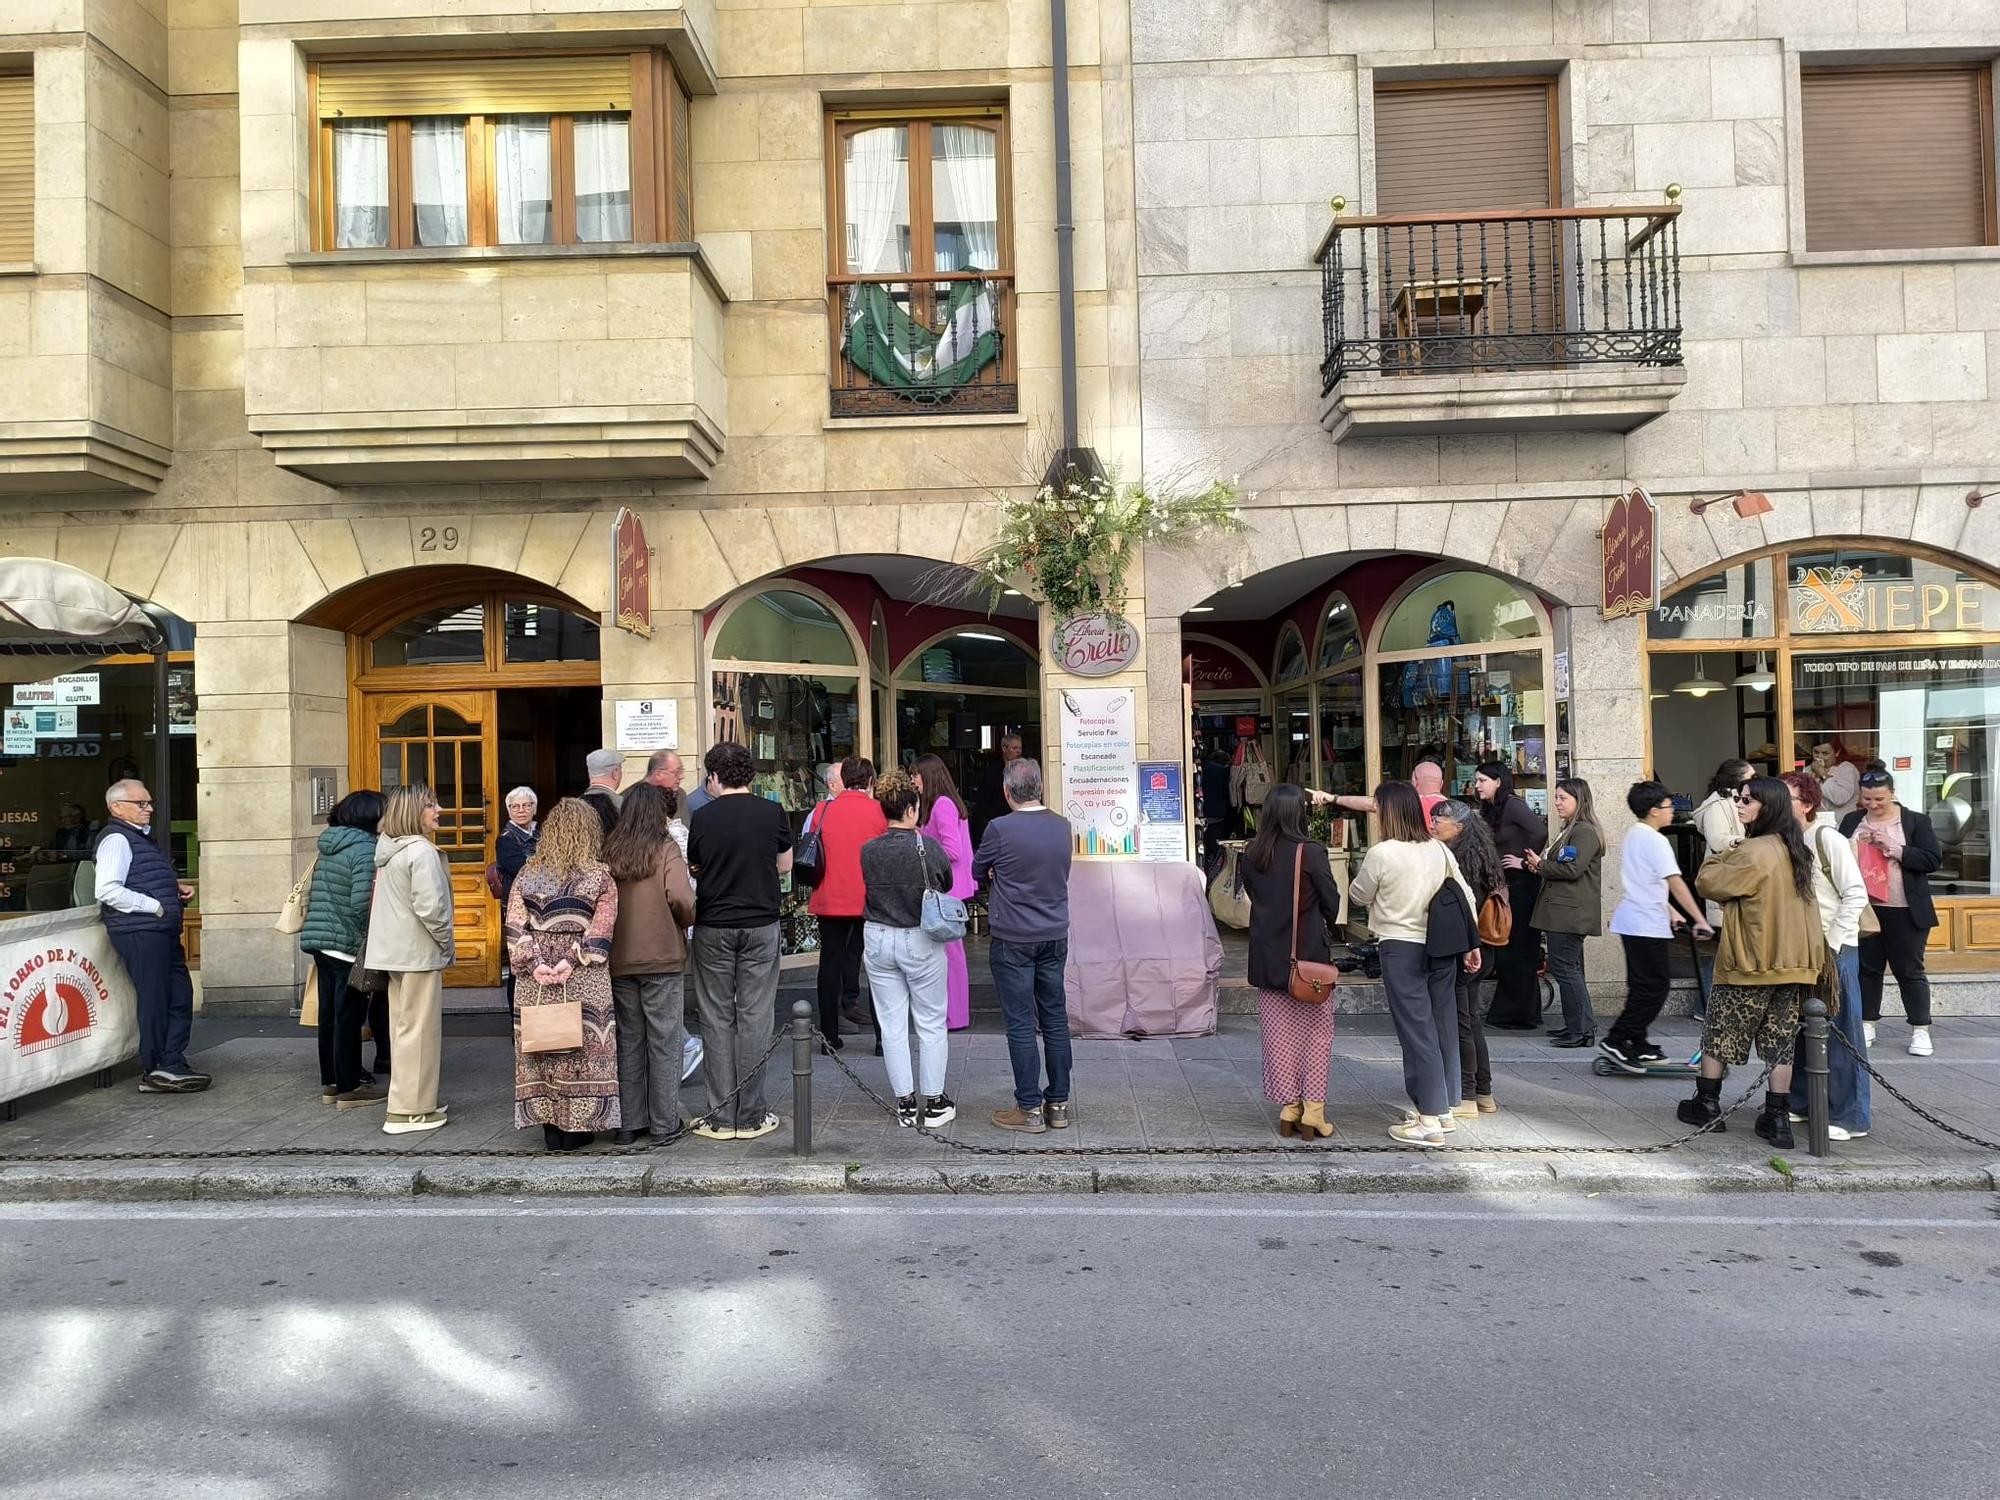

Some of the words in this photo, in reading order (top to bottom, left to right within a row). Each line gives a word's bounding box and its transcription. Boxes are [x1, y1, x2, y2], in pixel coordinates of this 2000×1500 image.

[419, 526, 459, 552] 29
[1659, 600, 1769, 623] PANADERÍA
[1804, 662, 1835, 673] TODO
[1835, 662, 1860, 672] TIPO
[1861, 662, 1875, 671] DE
[1876, 661, 1896, 671] PAN
[1898, 661, 1912, 671] DE
[1939, 660, 1947, 670] Y
[57, 675, 99, 684] BOCADILLOS
[16, 691, 55, 701] GLUTEN
[1080, 718, 1116, 726] Fotocopias
[1066, 741, 1101, 750] Fotocopias
[1073, 764, 1125, 772] Plastificaciones
[1069, 776, 1130, 784] Encuadernaciones
[1072, 788, 1105, 797] Impresión
[1106, 787, 1127, 795] desde
[47, 949, 64, 963] DE
